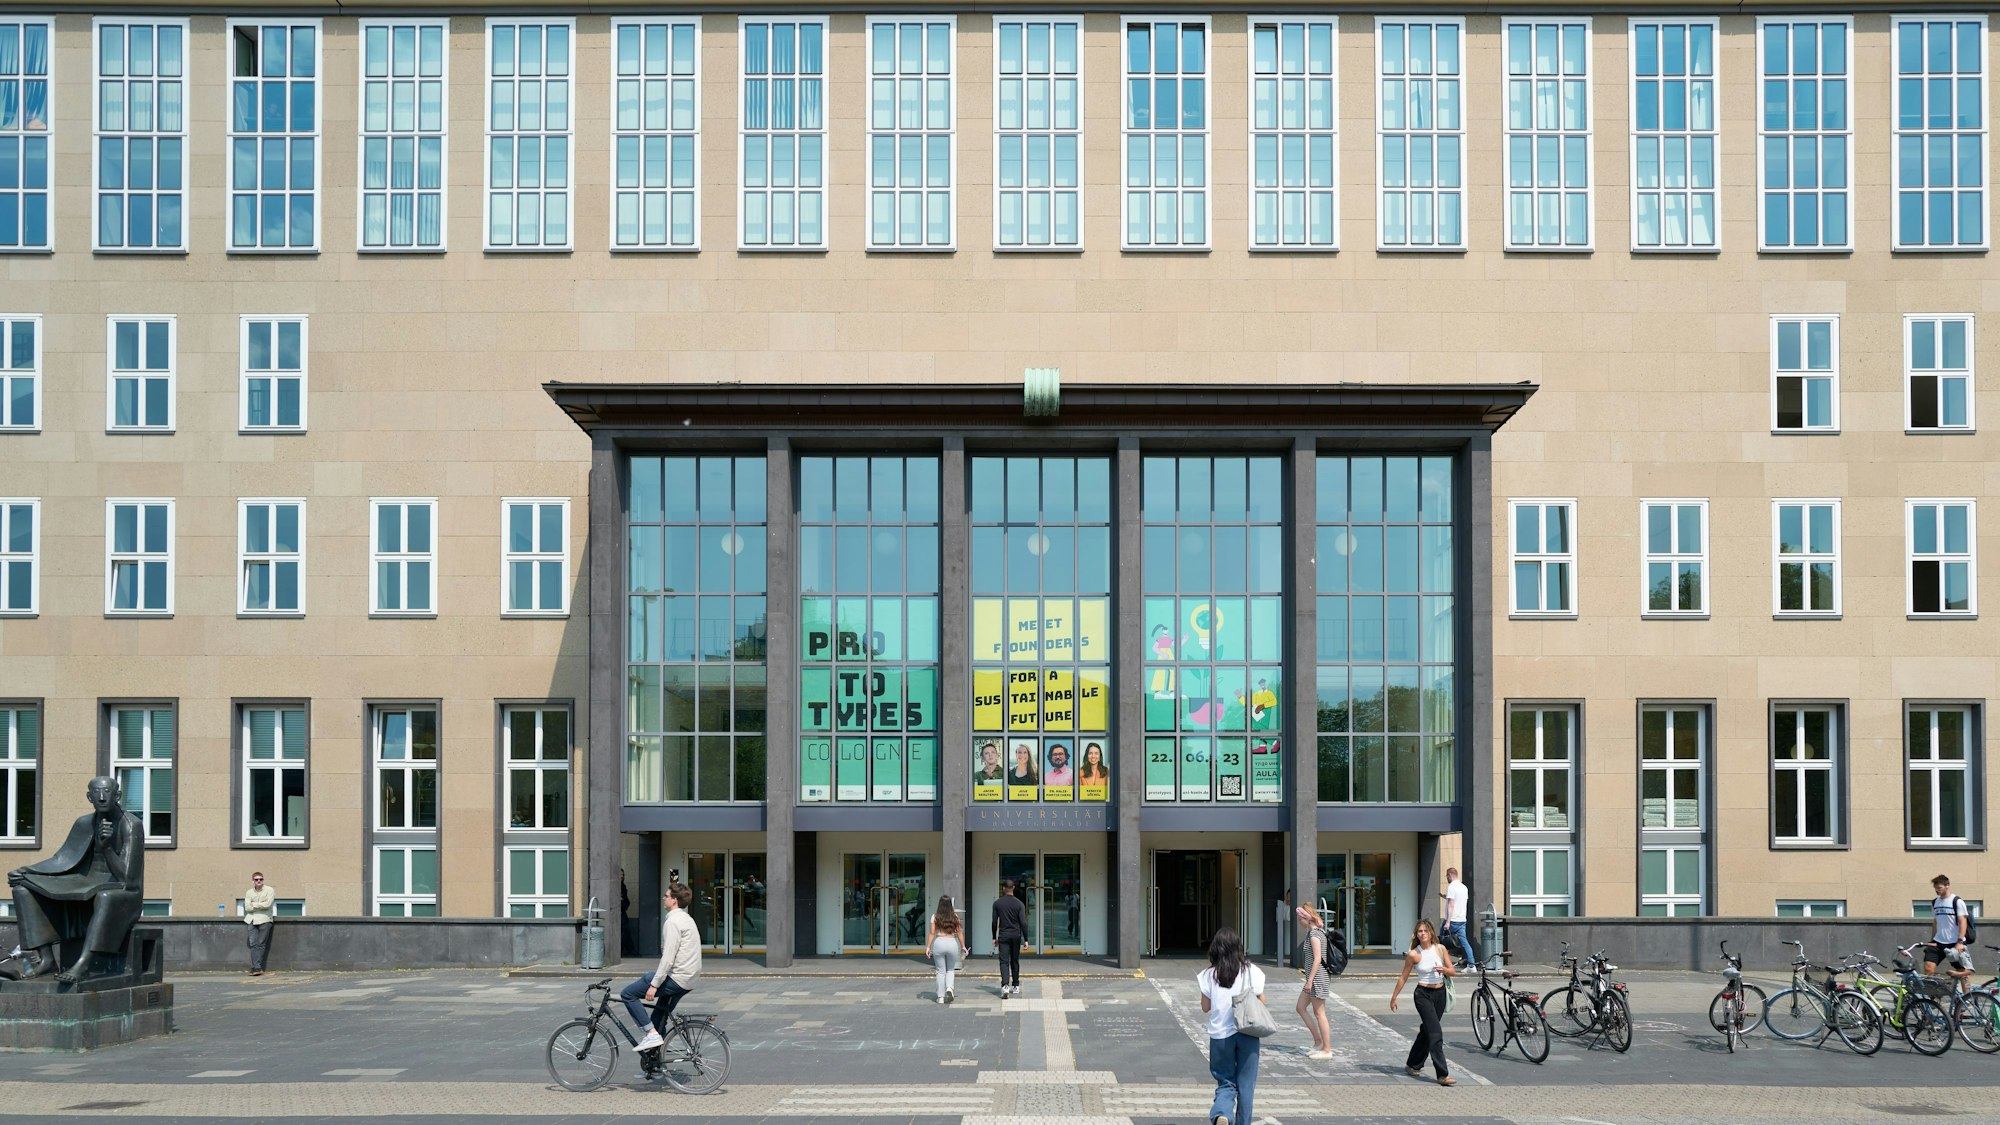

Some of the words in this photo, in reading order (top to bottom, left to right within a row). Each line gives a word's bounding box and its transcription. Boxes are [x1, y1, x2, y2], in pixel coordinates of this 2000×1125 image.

[1018, 618, 1063, 632] MEET
[809, 631, 886, 656] PRO
[993, 636, 1090, 653] FOUNDERS
[839, 672, 886, 697] TO
[1010, 672, 1036, 683] FOR
[1049, 670, 1058, 681] A
[808, 702, 923, 727] TYPES
[1010, 710, 1072, 725] FUTURE
[808, 743, 922, 761] COLOGNE
[1151, 753, 1173, 763] 22.
[1223, 753, 1240, 766] 23
[981, 808, 1102, 819] UNIVERSITÄT
